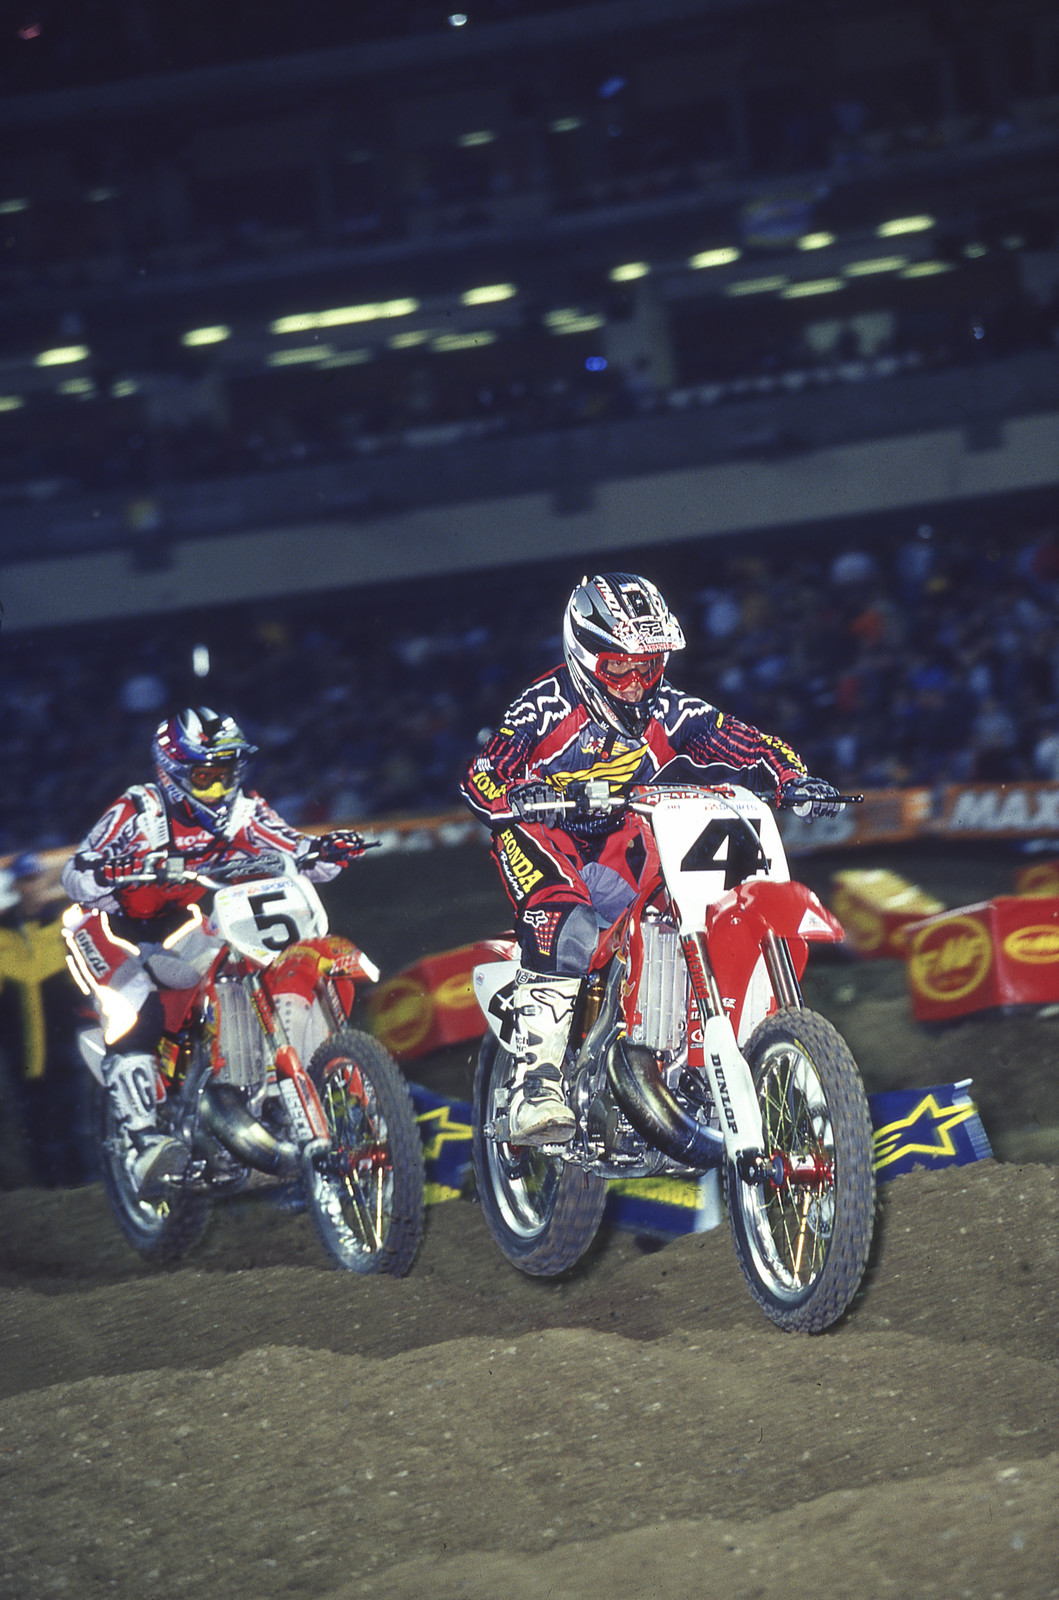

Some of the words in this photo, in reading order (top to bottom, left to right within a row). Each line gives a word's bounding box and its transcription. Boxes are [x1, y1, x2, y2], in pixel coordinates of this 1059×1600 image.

[501, 828, 544, 894] HONDA
[501, 851, 525, 900] Racing
[680, 818, 772, 891] 4
[247, 890, 300, 951] 5
[684, 940, 710, 999] SHOWA
[711, 1053, 739, 1134] DUNLOP
